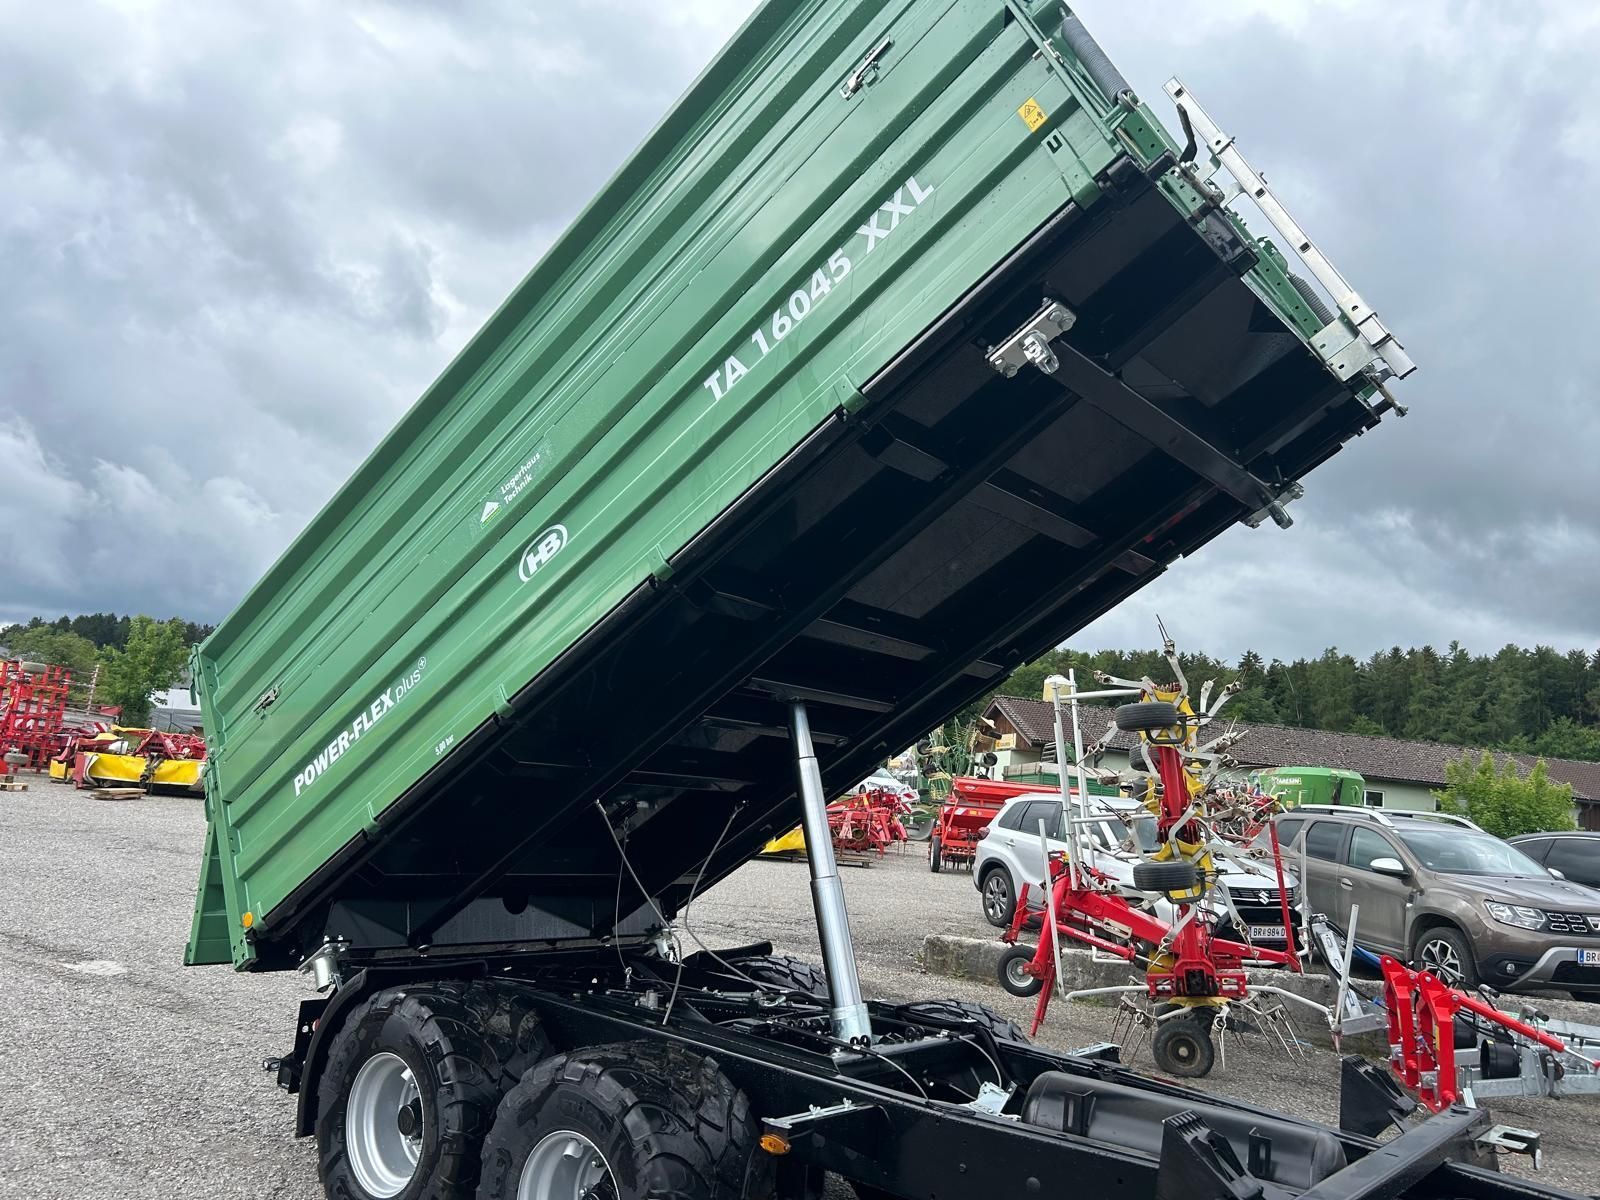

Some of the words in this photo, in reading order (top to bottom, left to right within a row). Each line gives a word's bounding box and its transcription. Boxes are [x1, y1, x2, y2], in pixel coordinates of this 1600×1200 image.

[703, 355, 749, 401] TA
[751, 247, 852, 355] 16045
[855, 176, 935, 254] XXL
[501, 452, 541, 495] Lagerhaus
[504, 473, 533, 505] Technik
[525, 531, 562, 576] HB
[294, 688, 395, 796] POWER-FLEX
[1585, 952, 1597, 962] BR
